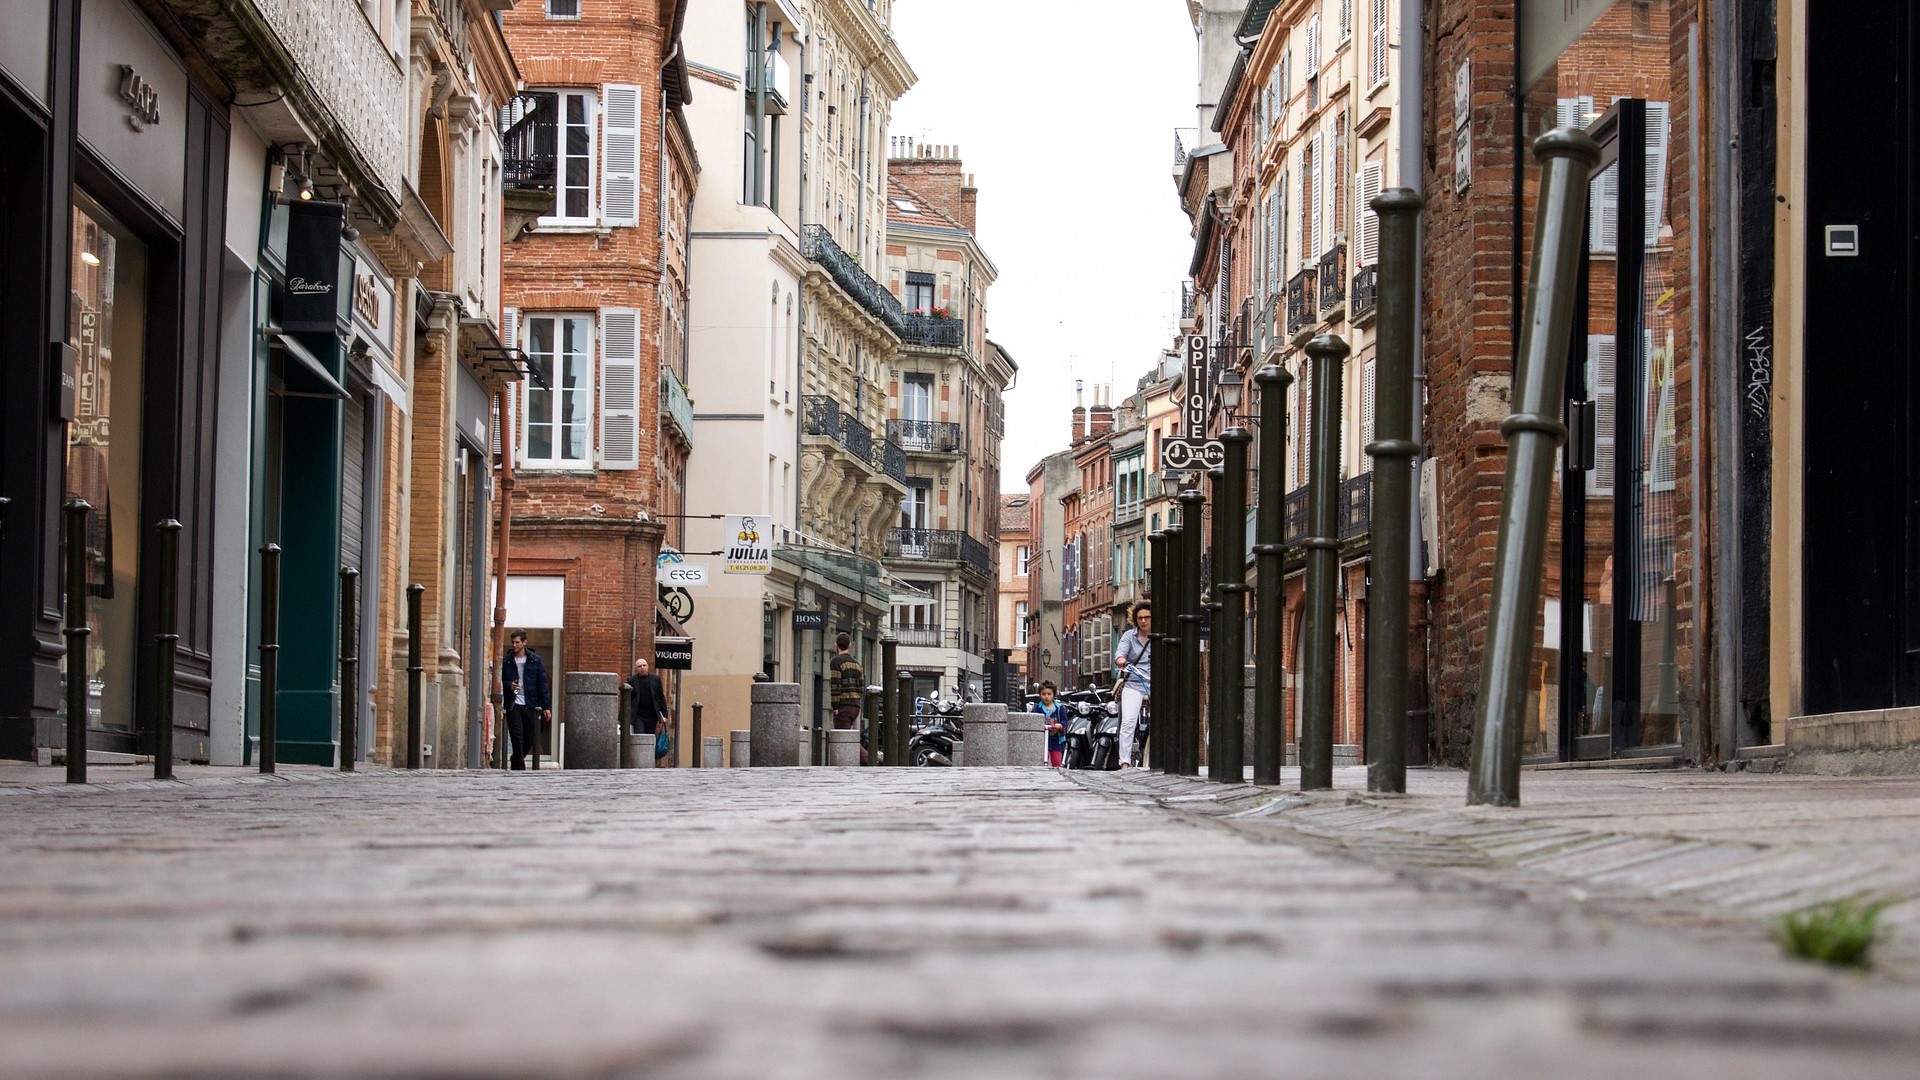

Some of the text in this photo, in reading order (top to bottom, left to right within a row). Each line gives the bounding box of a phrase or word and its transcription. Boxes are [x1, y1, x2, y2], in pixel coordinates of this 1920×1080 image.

[121, 64, 160, 124] ZAPA
[289, 277, 333, 292] Paraboot
[1190, 336, 1204, 439] OPTIQUE
[727, 548, 768, 560] JUILIA
[670, 569, 702, 580] ERES
[796, 614, 821, 623] BOSS
